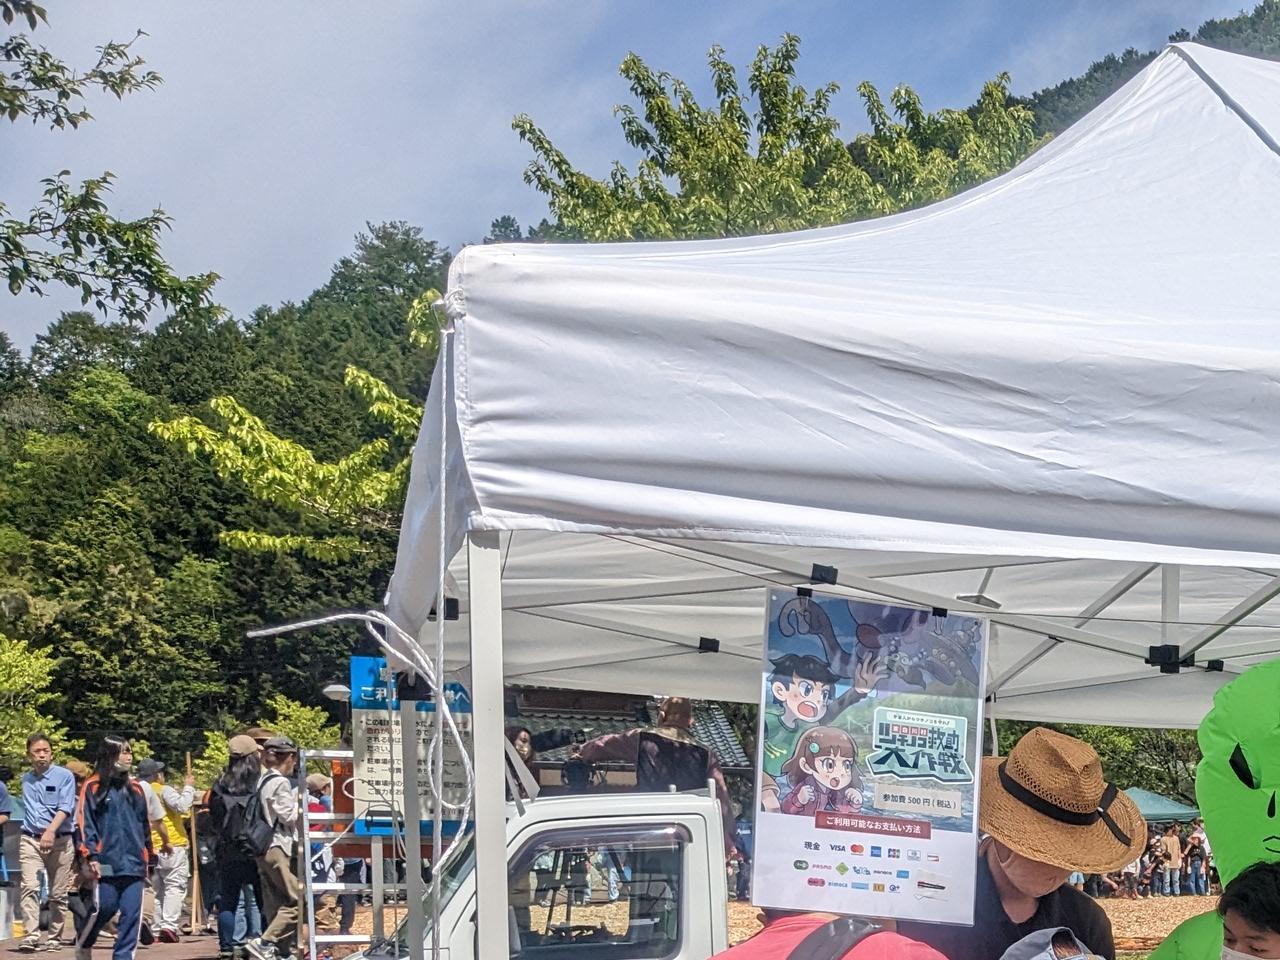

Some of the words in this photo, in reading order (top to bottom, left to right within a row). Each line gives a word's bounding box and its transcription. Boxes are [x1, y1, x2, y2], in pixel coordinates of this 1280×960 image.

[873, 746, 967, 775] 大作戦
[826, 817, 921, 834] ご利用可能なお支払い方法
[804, 841, 820, 851] 現金
[830, 844, 846, 852] VISA
